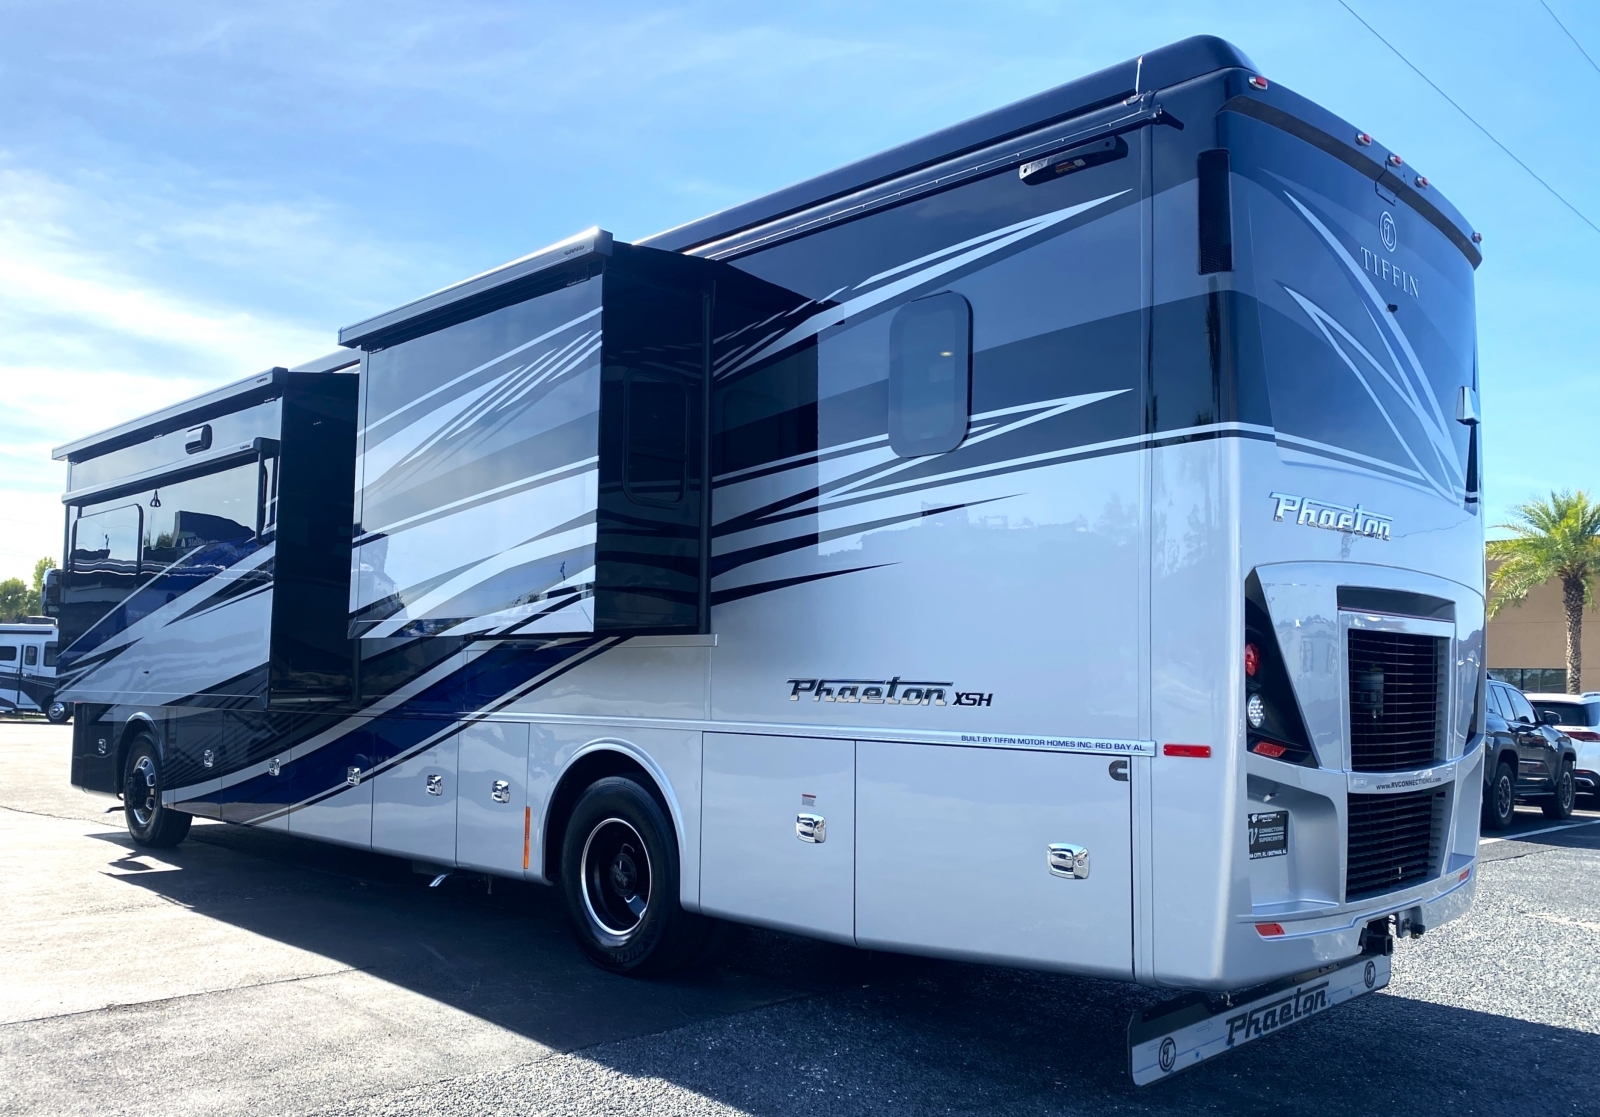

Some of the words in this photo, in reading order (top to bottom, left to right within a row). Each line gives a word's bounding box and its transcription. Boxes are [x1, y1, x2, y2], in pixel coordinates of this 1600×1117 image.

[1360, 246, 1419, 299] TIFFIN
[1269, 491, 1394, 541] Phaeton
[786, 676, 954, 706] Phaeton
[951, 691, 994, 707] XSH
[993, 736, 1016, 744] TIFFIN
[1017, 738, 1045, 746] MOTOR
[1046, 739, 1076, 747] HOMES
[1376, 777, 1441, 790] www.RVCONNECTIONS.com
[1226, 981, 1329, 1045] Phaeton
